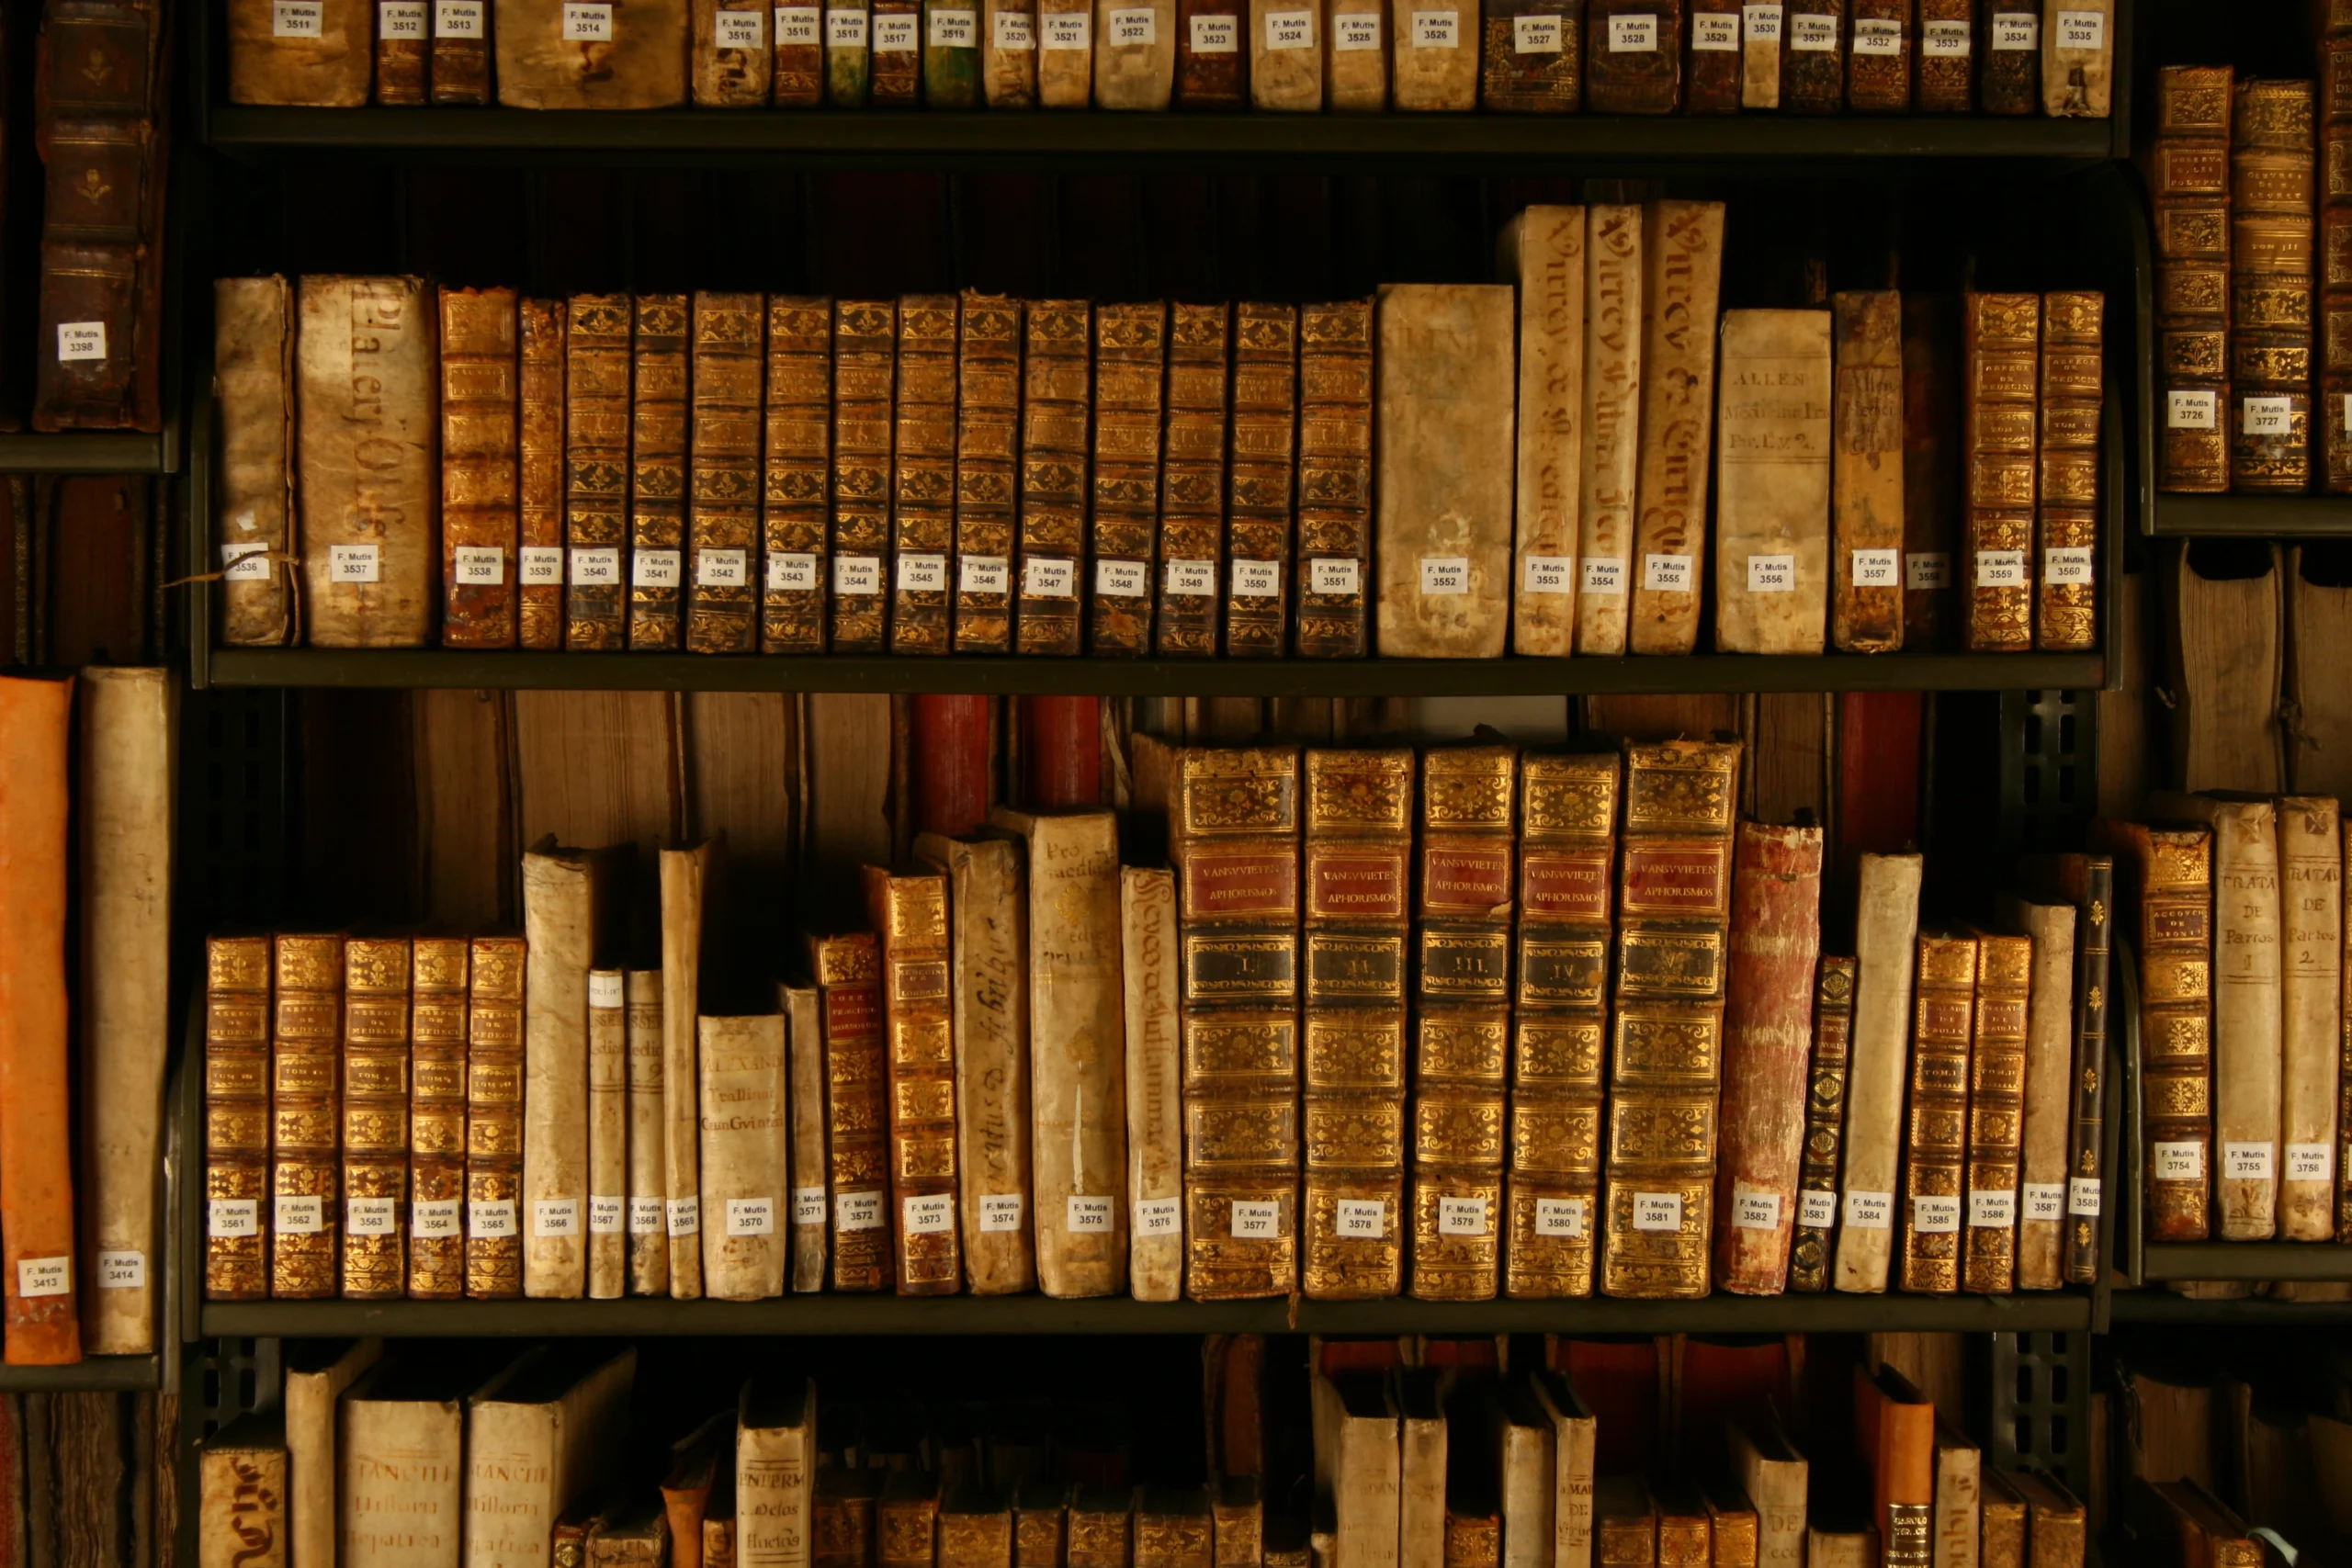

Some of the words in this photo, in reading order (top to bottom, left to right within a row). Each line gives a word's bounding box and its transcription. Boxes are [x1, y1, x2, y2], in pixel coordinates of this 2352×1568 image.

[442, 7, 450, 16] F.
[452, 8, 477, 17] Mutis
[571, 11, 579, 19] F.
[582, 12, 605, 20] Mutis
[447, 20, 471, 30] 3513
[722, 18, 730, 27] F.
[733, 19, 756, 28] Mutis
[936, 17, 945, 26] F.
[947, 17, 971, 26] Mutis
[1114, 17, 1124, 25] F.
[1272, 20, 1281, 28] F.
[1283, 19, 1306, 28] Mutis
[1419, 18, 1427, 27] F.
[1429, 18, 1453, 27] Mutis
[2063, 18, 2072, 27] F.
[2074, 19, 2098, 28] Mutis
[576, 23, 600, 32] 3514
[877, 22, 886, 30] F.
[888, 22, 911, 30] Mutis
[1521, 24, 1530, 32] F.
[1532, 23, 1555, 31] Mutis
[1615, 22, 1624, 30] F.
[1626, 22, 1650, 30] Mutis
[1797, 21, 1806, 29] F.
[1808, 22, 1831, 31] Mutis
[728, 30, 752, 40] 3515
[942, 28, 965, 39] 3519
[1122, 27, 1144, 37] 3522
[1279, 30, 1302, 41] 3524
[1424, 30, 1447, 39] 3526
[2068, 30, 2092, 40] 3535
[884, 33, 907, 43] 3517
[1527, 34, 1551, 45] 3527
[1622, 34, 1645, 44] 3528
[1803, 33, 1826, 42] 3531
[70, 342, 93, 352] 3398
[1734, 372, 1805, 388] ALLEN
[2175, 399, 2183, 407] F.
[2186, 399, 2209, 407] Mutis
[2180, 410, 2204, 420] 3726
[338, 553, 346, 561] F.
[705, 557, 714, 565] F.
[716, 557, 740, 565] Mutis
[639, 558, 648, 566] F.
[650, 558, 673, 566] Mutis
[1652, 561, 1660, 570] F.
[1662, 562, 1685, 570] Mutis
[1858, 558, 1867, 566] F.
[344, 564, 367, 573] 3537
[1033, 566, 1041, 574] F.
[1044, 567, 1067, 576] Mutis
[1238, 567, 1247, 575] F.
[1250, 568, 1272, 576] Mutis
[1427, 566, 1436, 574] F.
[1532, 563, 1540, 571] F.
[1542, 564, 1565, 572] Mutis
[1754, 563, 1763, 571] F.
[645, 569, 668, 579] 3541
[710, 569, 734, 578] 3542
[1657, 573, 1679, 583] 3555
[1864, 570, 1886, 579] 3557
[1037, 578, 1061, 588] 3547
[1433, 577, 1456, 587] 3552
[1536, 575, 1559, 585] 3553
[1760, 574, 1782, 584] 3556
[1244, 579, 1267, 589] 3550
[1435, 880, 1503, 893] APHORISMOS
[1210, 887, 1278, 900] APHORISMOS
[1645, 886, 1713, 897] APHORISMOS
[1328, 893, 1396, 905] APHORISMOS
[1535, 891, 1602, 903] APHORISMOS
[2302, 898, 2326, 912] DE
[2243, 905, 2263, 919] DE
[2299, 951, 2315, 964] 2
[2231, 1151, 2240, 1159] F.
[2301, 1152, 2324, 1160] Mutis
[2237, 1162, 2260, 1171] 3755
[2297, 1164, 2319, 1172] 3756
[1640, 1200, 1648, 1209] F.
[1650, 1201, 1675, 1209] Mutis
[1975, 1198, 1984, 1206] F.
[1986, 1198, 2008, 1206] Mutis
[280, 1204, 289, 1213] F.
[1343, 1207, 1352, 1215] F.
[1354, 1208, 1377, 1216] Mutis
[1445, 1204, 1454, 1213] F.
[1456, 1205, 1479, 1213] Mutis
[1543, 1206, 1551, 1214] F.
[1553, 1207, 1577, 1215] Mutis
[1921, 1203, 1929, 1212] F.
[1249, 1209, 1272, 1217] Mutis
[1645, 1212, 1668, 1222] 3581
[1981, 1210, 2004, 1219] 3586
[288, 1215, 310, 1224] 3562
[740, 1217, 763, 1227] 3570
[1148, 1217, 1170, 1228] 3576
[1349, 1219, 1372, 1229] 3578
[1451, 1216, 1474, 1226] 3579
[1547, 1218, 1571, 1227] 3580
[1927, 1215, 1950, 1224] 3585
[1243, 1220, 1267, 1230] 3577
[28, 1268, 36, 1276] F.
[33, 1278, 57, 1288] 3413
[1568, 1504, 1589, 1517] DE
[1770, 1515, 1799, 1533] DE
